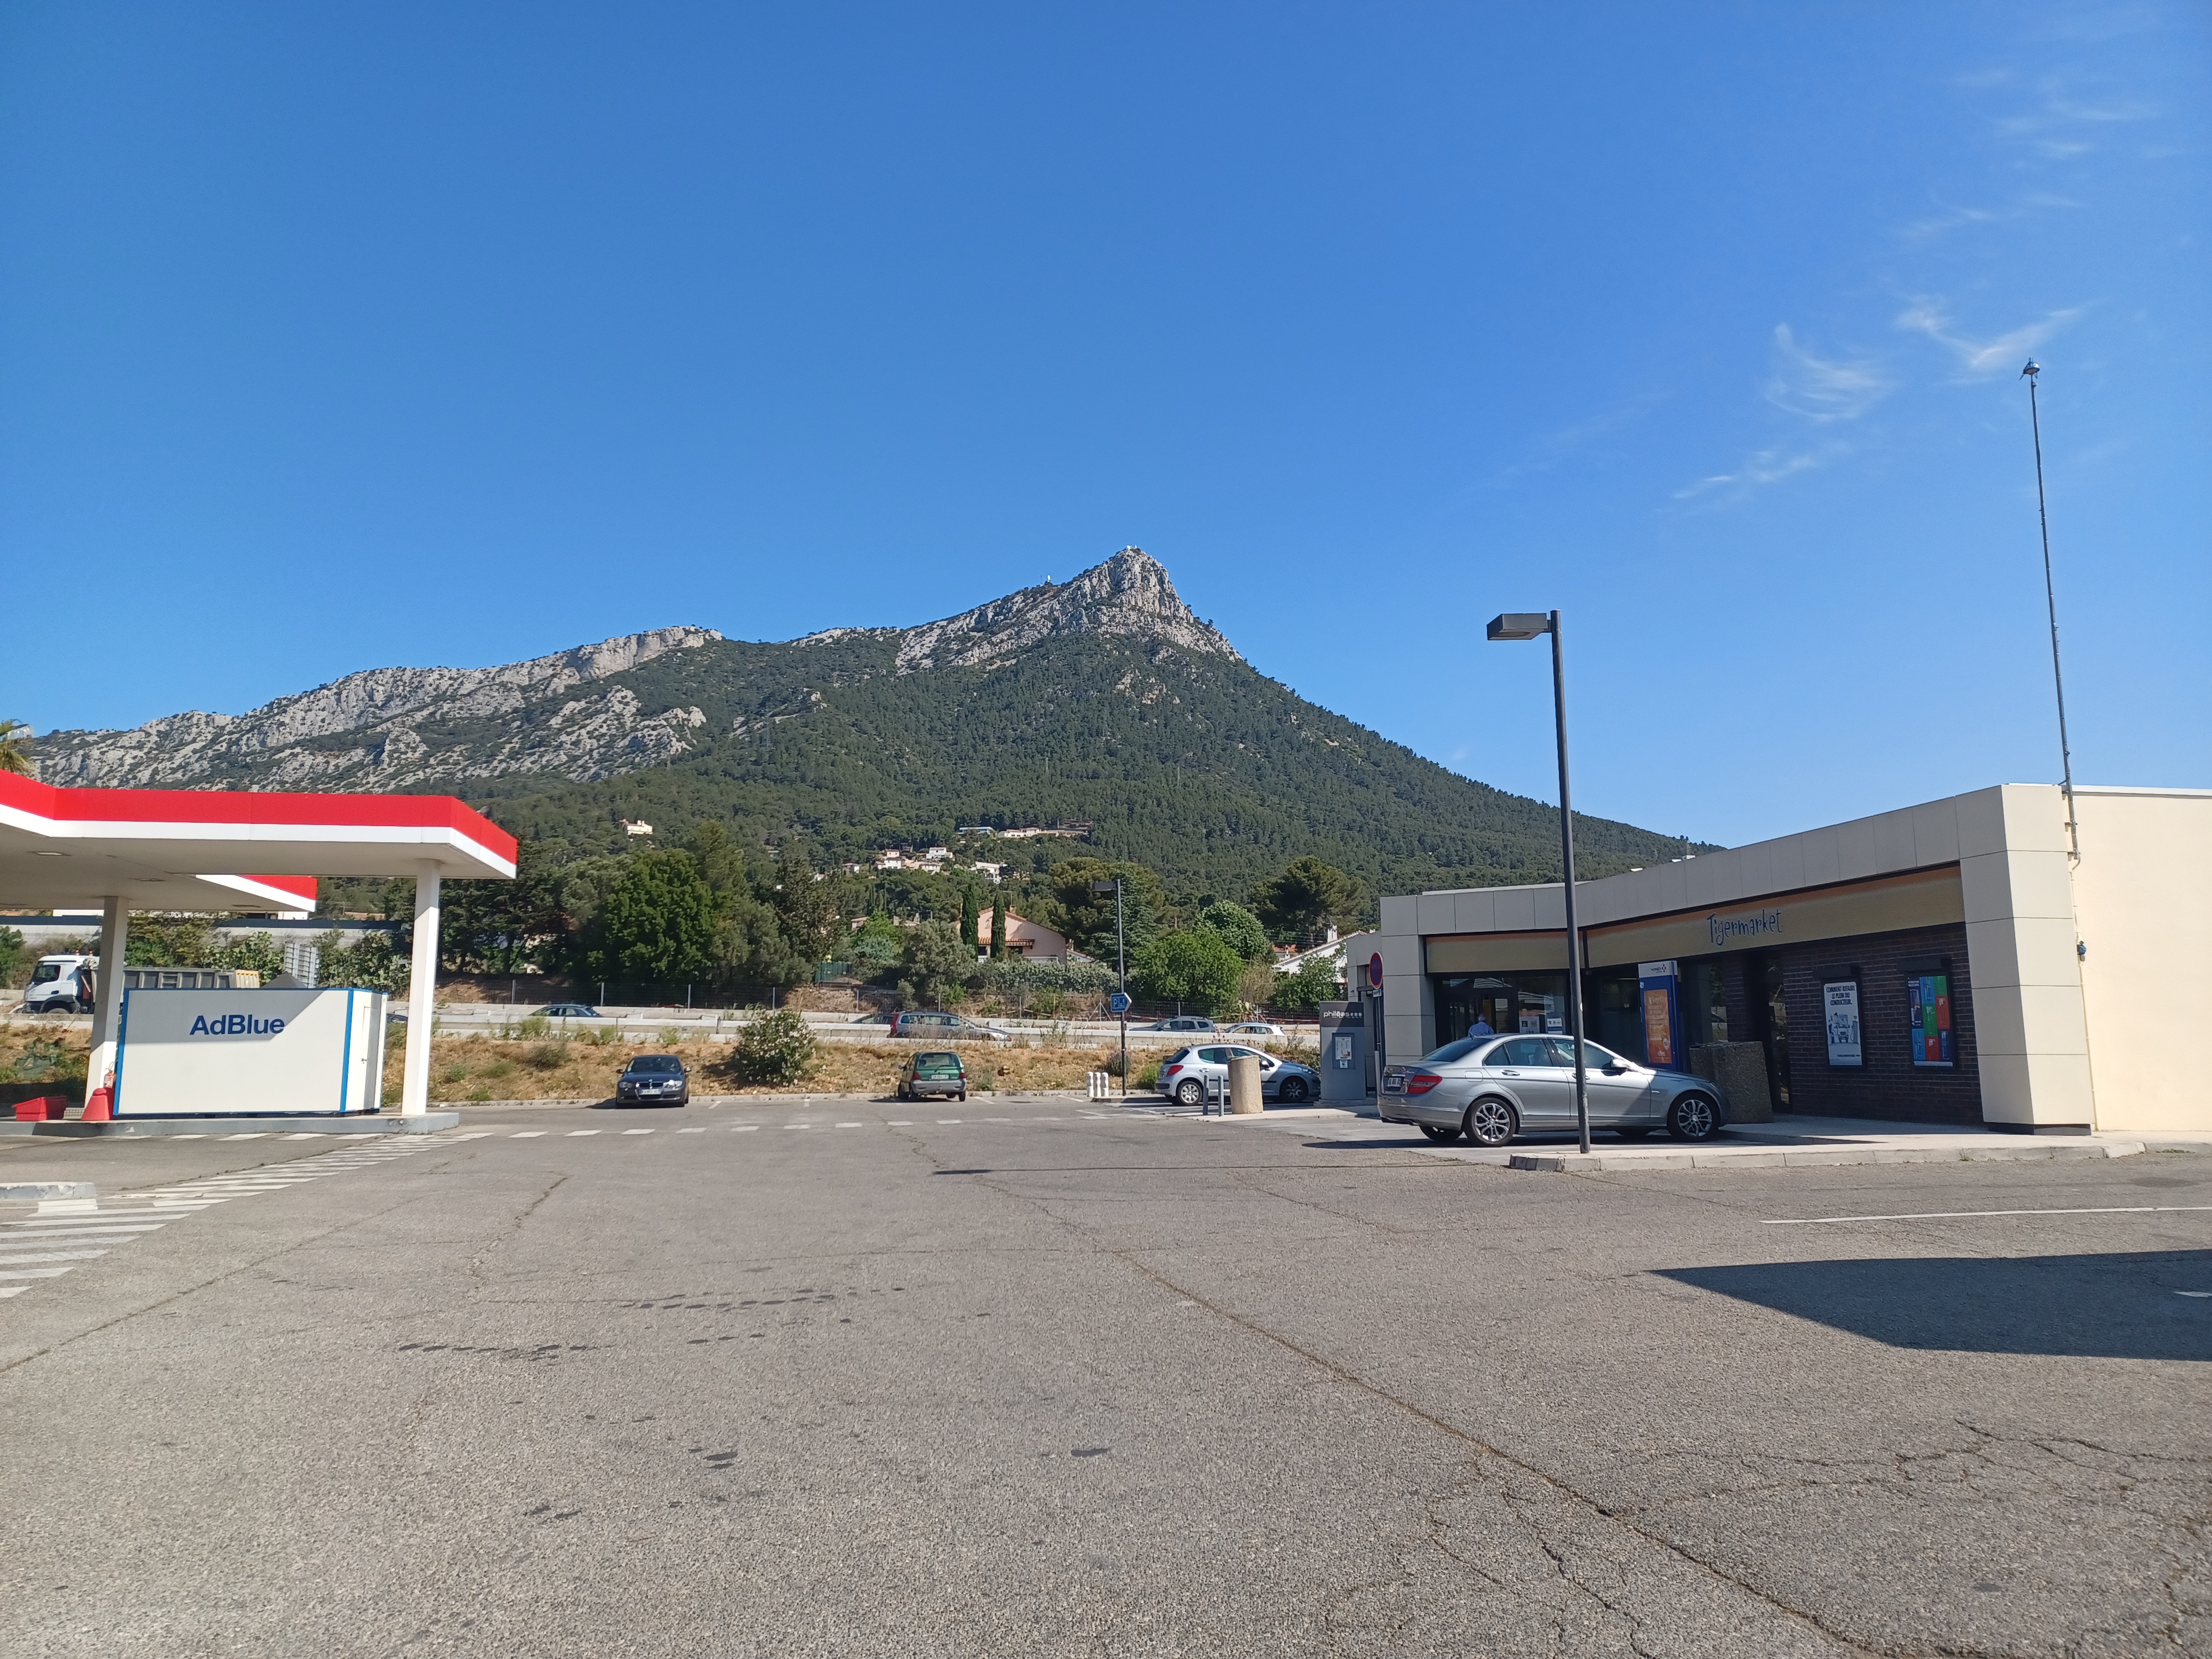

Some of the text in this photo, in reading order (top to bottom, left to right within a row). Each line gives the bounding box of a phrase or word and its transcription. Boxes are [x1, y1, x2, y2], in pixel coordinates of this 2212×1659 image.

[1707, 908, 1782, 946] Tigermarket
[1114, 998, 1120, 1008] P
[189, 1014, 285, 1035] AdBlue
